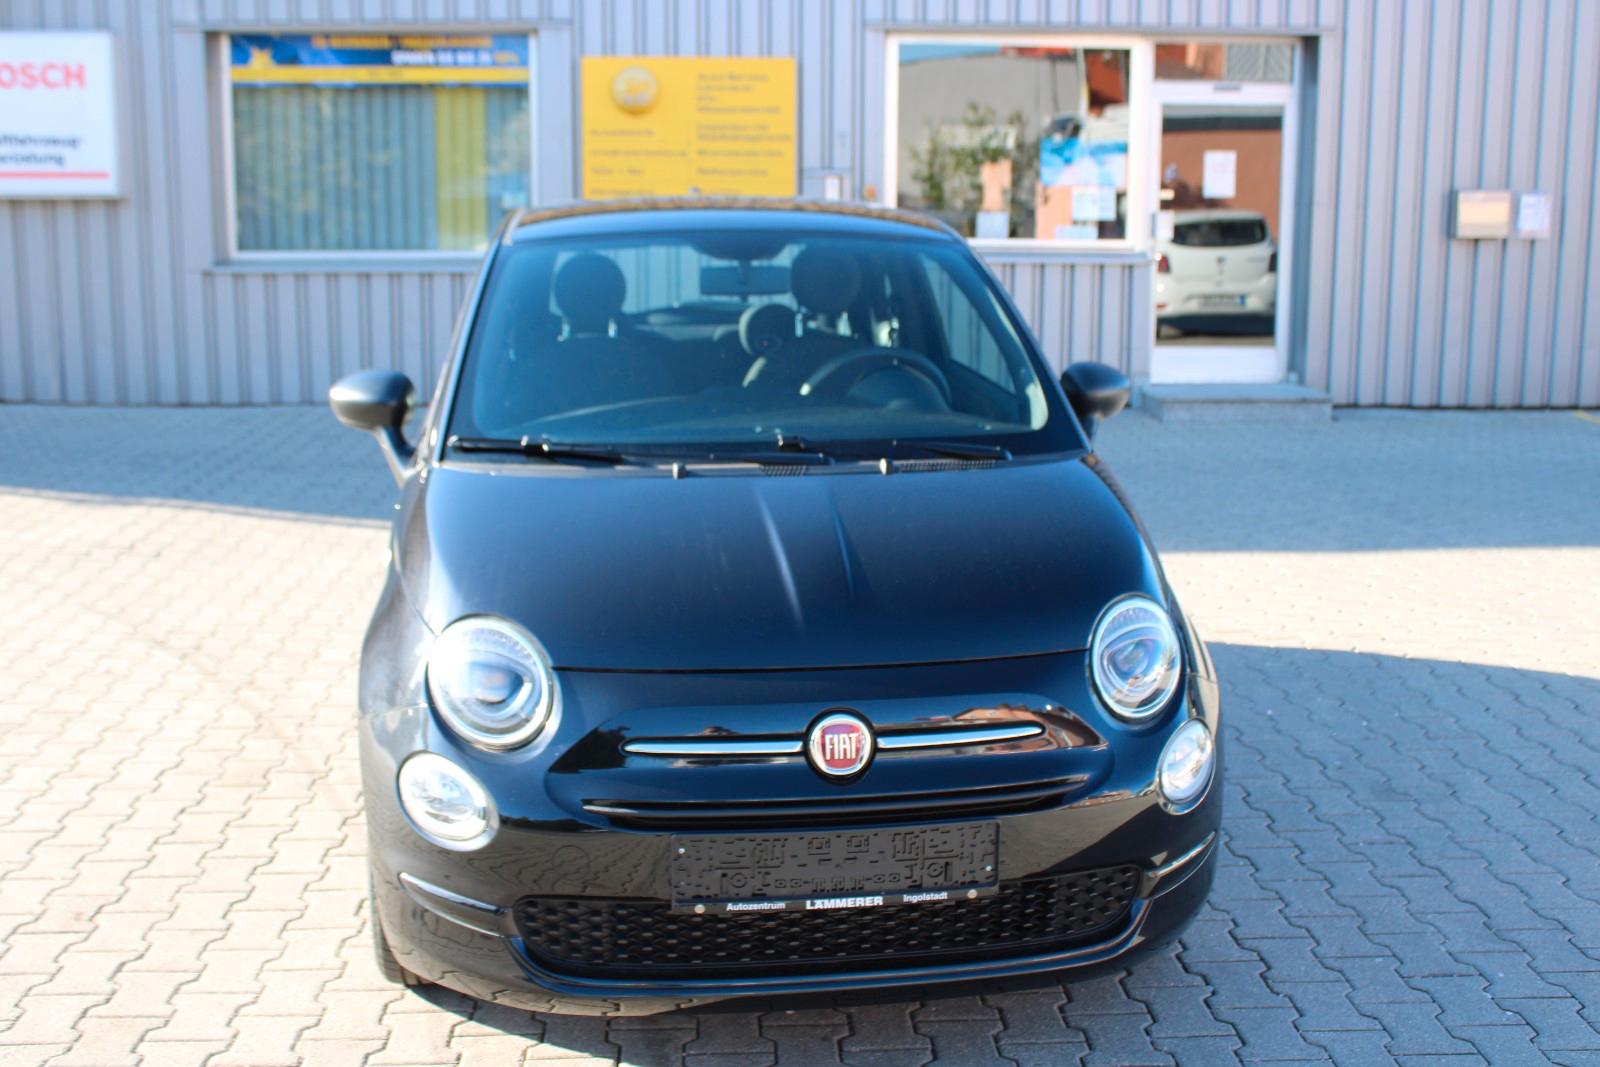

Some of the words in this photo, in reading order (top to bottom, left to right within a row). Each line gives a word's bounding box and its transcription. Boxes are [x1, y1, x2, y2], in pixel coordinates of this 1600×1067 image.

[824, 733, 860, 761] FIAT
[726, 902, 786, 911] Autozentrum
[903, 891, 948, 904] Ingolstadt
